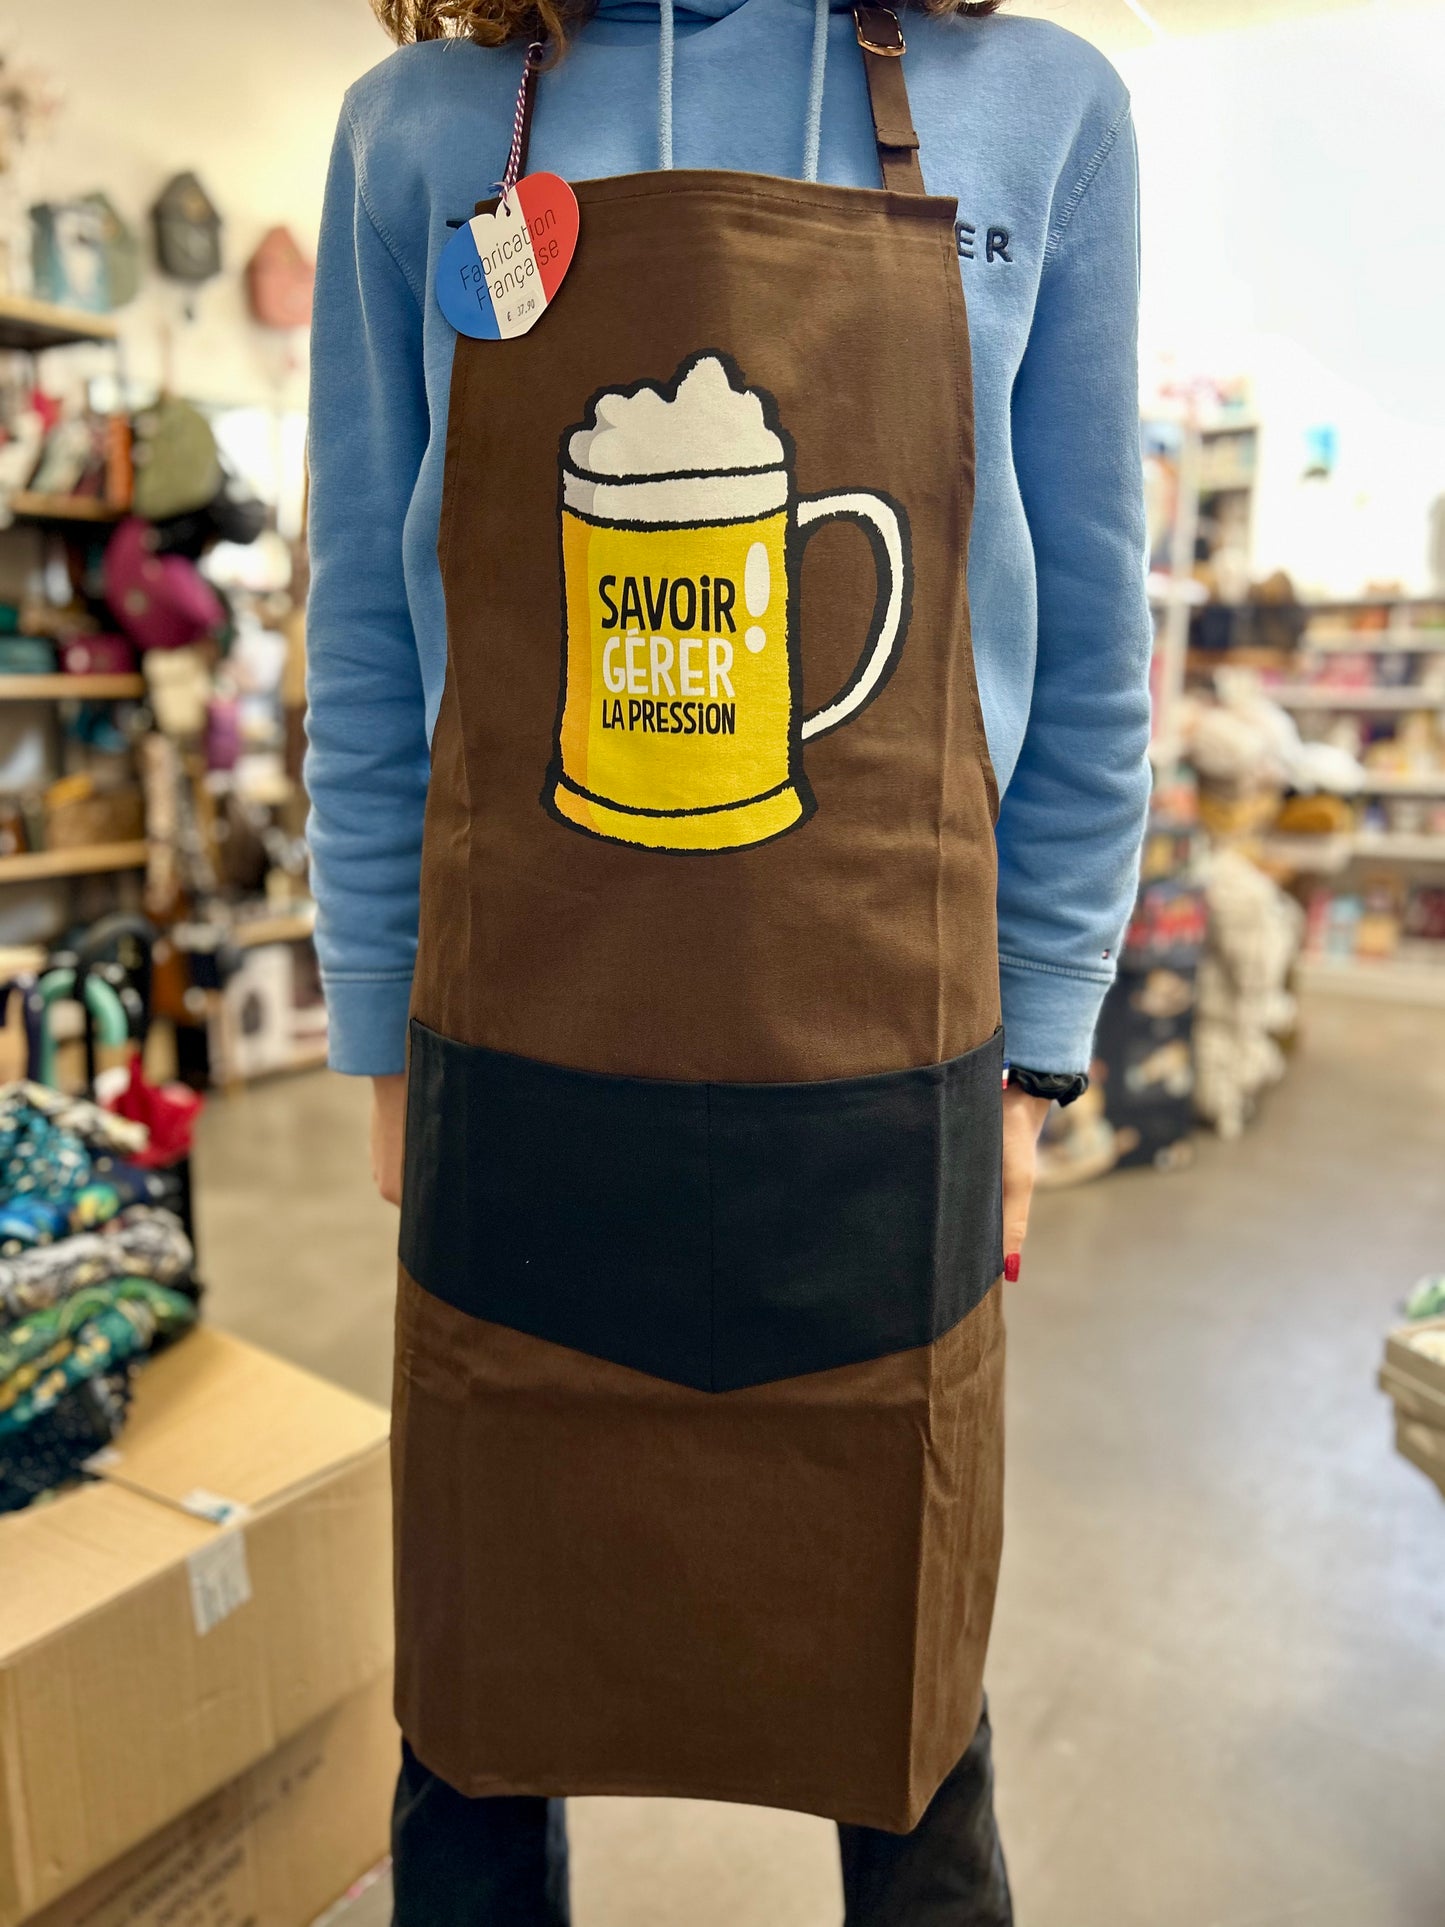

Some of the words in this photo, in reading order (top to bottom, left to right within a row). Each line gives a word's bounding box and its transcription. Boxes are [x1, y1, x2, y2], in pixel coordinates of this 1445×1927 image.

[459, 209, 557, 290] Fabrication
[475, 239, 559, 311] Française
[602, 628, 736, 698] GÉRER
[602, 699, 625, 730] LA
